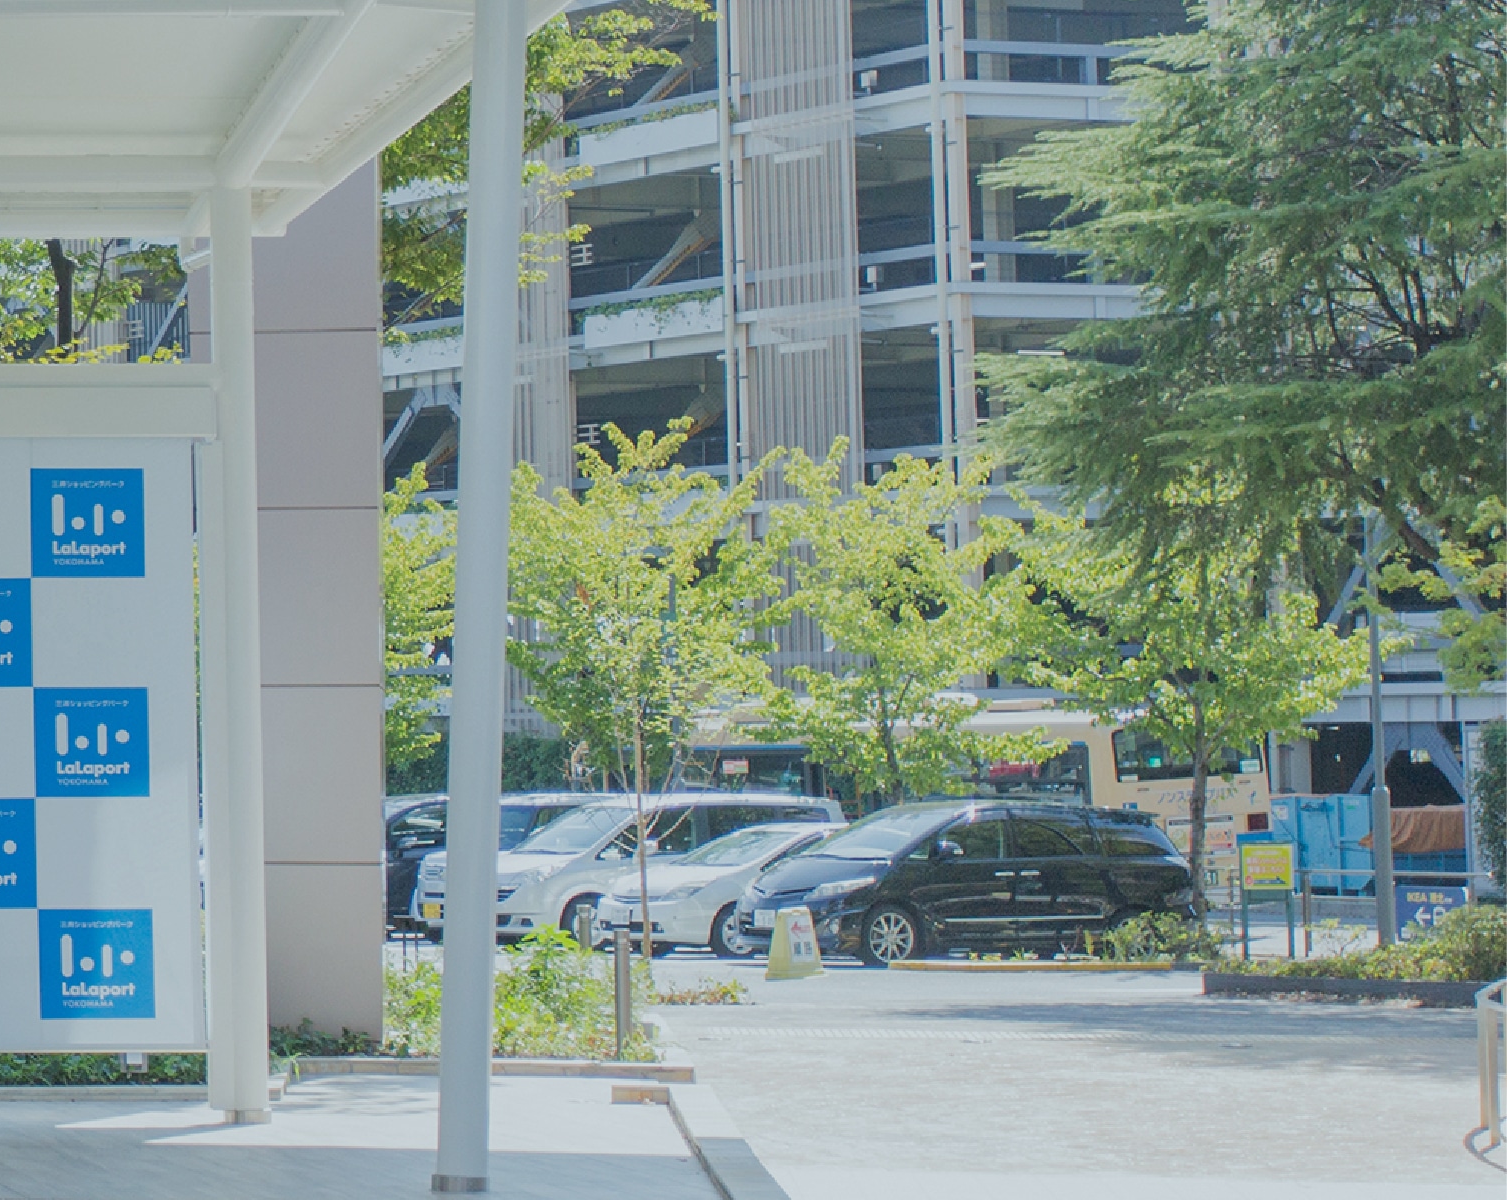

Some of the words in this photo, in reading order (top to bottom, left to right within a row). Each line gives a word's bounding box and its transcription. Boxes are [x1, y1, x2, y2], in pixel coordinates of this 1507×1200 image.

[51, 540, 127, 559] LaLaport
[56, 760, 131, 779] LaLaport
[62, 982, 136, 1001] LaLaport
